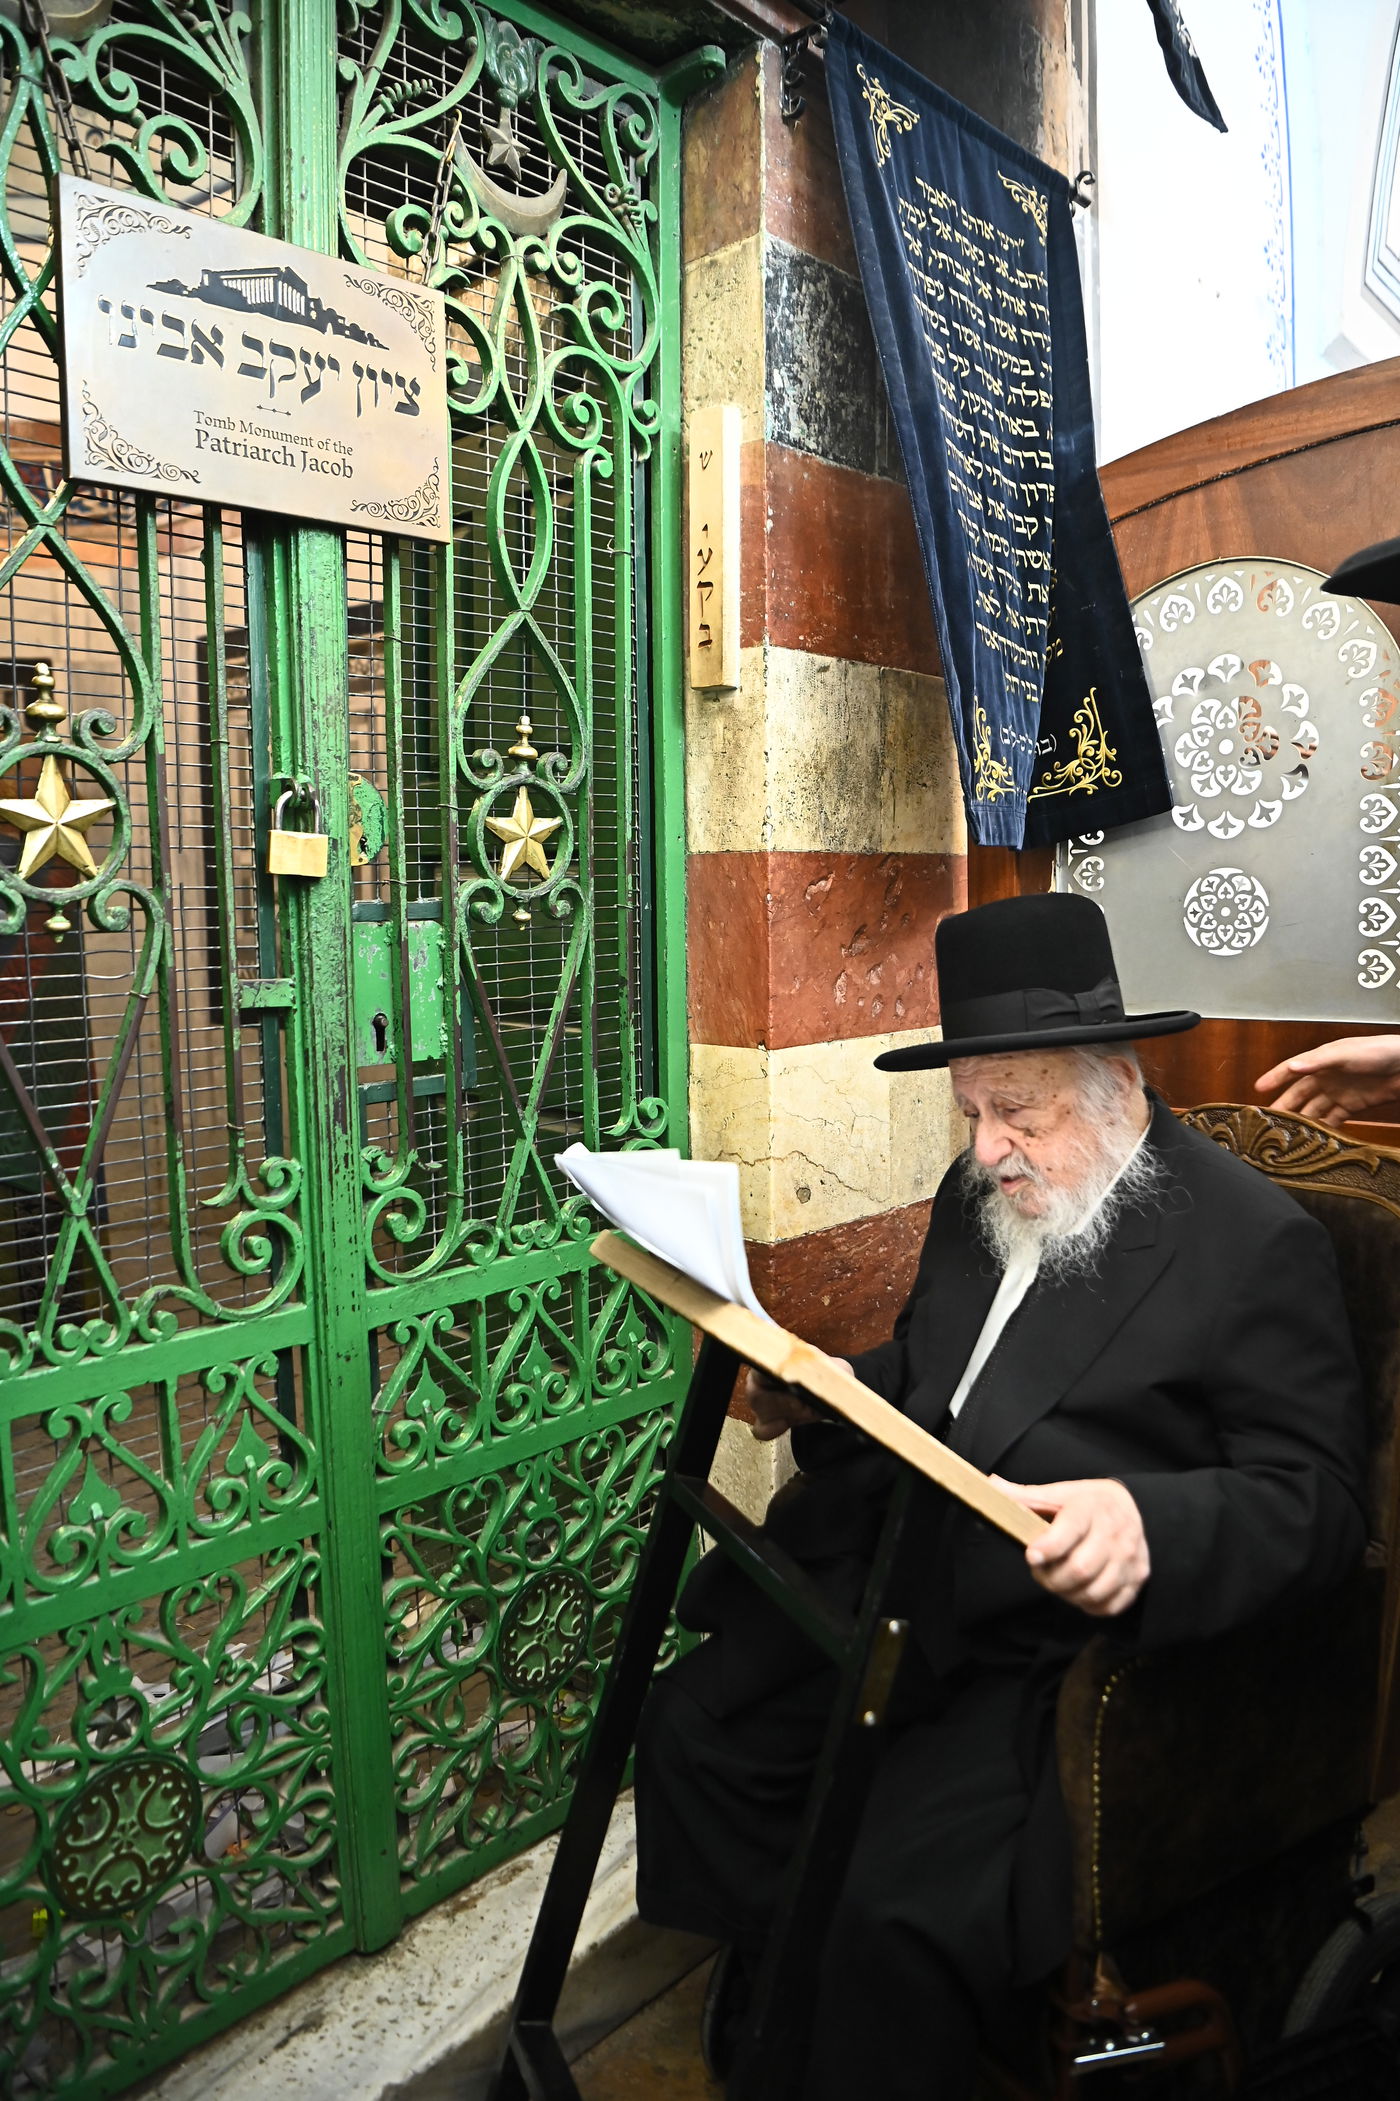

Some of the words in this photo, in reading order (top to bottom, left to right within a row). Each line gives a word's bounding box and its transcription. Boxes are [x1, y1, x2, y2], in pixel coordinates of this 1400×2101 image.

[915, 176, 959, 218] ויאמר
[902, 221, 923, 258] אל
[928, 207, 953, 242] אל
[961, 206, 995, 240] אותם
[954, 229, 986, 267] נאסף
[973, 267, 993, 301] אל
[996, 286, 1028, 317] אותי
[949, 286, 986, 329] בשדה
[97, 293, 226, 371] אבינו
[952, 320, 982, 352] אשר
[989, 313, 1018, 344] אשר
[236, 329, 342, 407] יעקב
[946, 343, 971, 378] על
[983, 340, 1035, 376] במערה
[352, 360, 422, 418] ציון
[974, 363, 1005, 397] אשר
[193, 410, 237, 432] Tomb
[239, 419, 315, 449] Monument
[317, 436, 331, 451] of
[333, 438, 354, 457] the
[994, 407, 1040, 438] בארץ
[194, 427, 297, 469] Patriarch
[300, 449, 354, 480] Jacob
[979, 428, 1000, 455] את
[698, 449, 714, 472] ש
[987, 496, 1007, 522] את
[696, 523, 714, 649] יעקב
